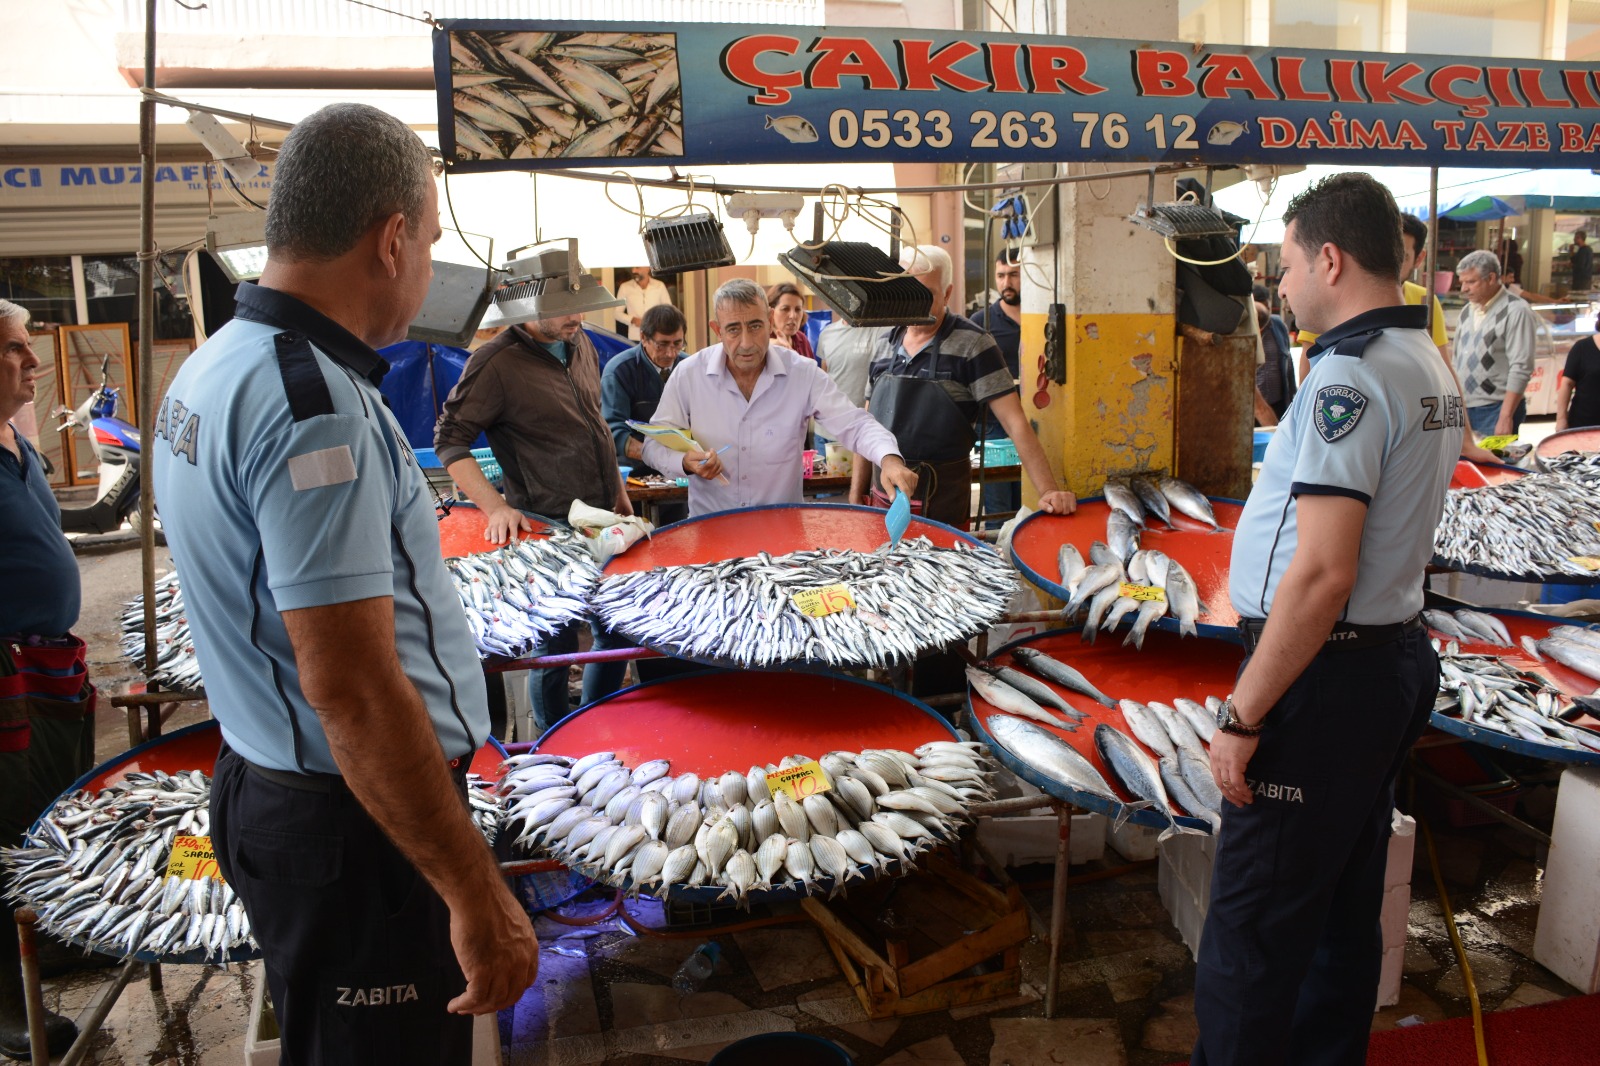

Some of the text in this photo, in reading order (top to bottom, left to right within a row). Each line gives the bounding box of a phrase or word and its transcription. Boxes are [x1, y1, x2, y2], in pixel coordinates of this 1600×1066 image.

[720, 33, 1600, 118] ÇAKIR BALIKÇILI
[828, 109, 1199, 150] 0533 263 76 12
[1257, 111, 1428, 150] DAİMA
[1433, 120, 1550, 152] TAZE
[0, 168, 42, 188] CI
[1324, 388, 1362, 404] TORBALI
[791, 775, 817, 800] 10
[1246, 779, 1304, 803] ZABITA
[336, 983, 418, 1006] ZABITA
